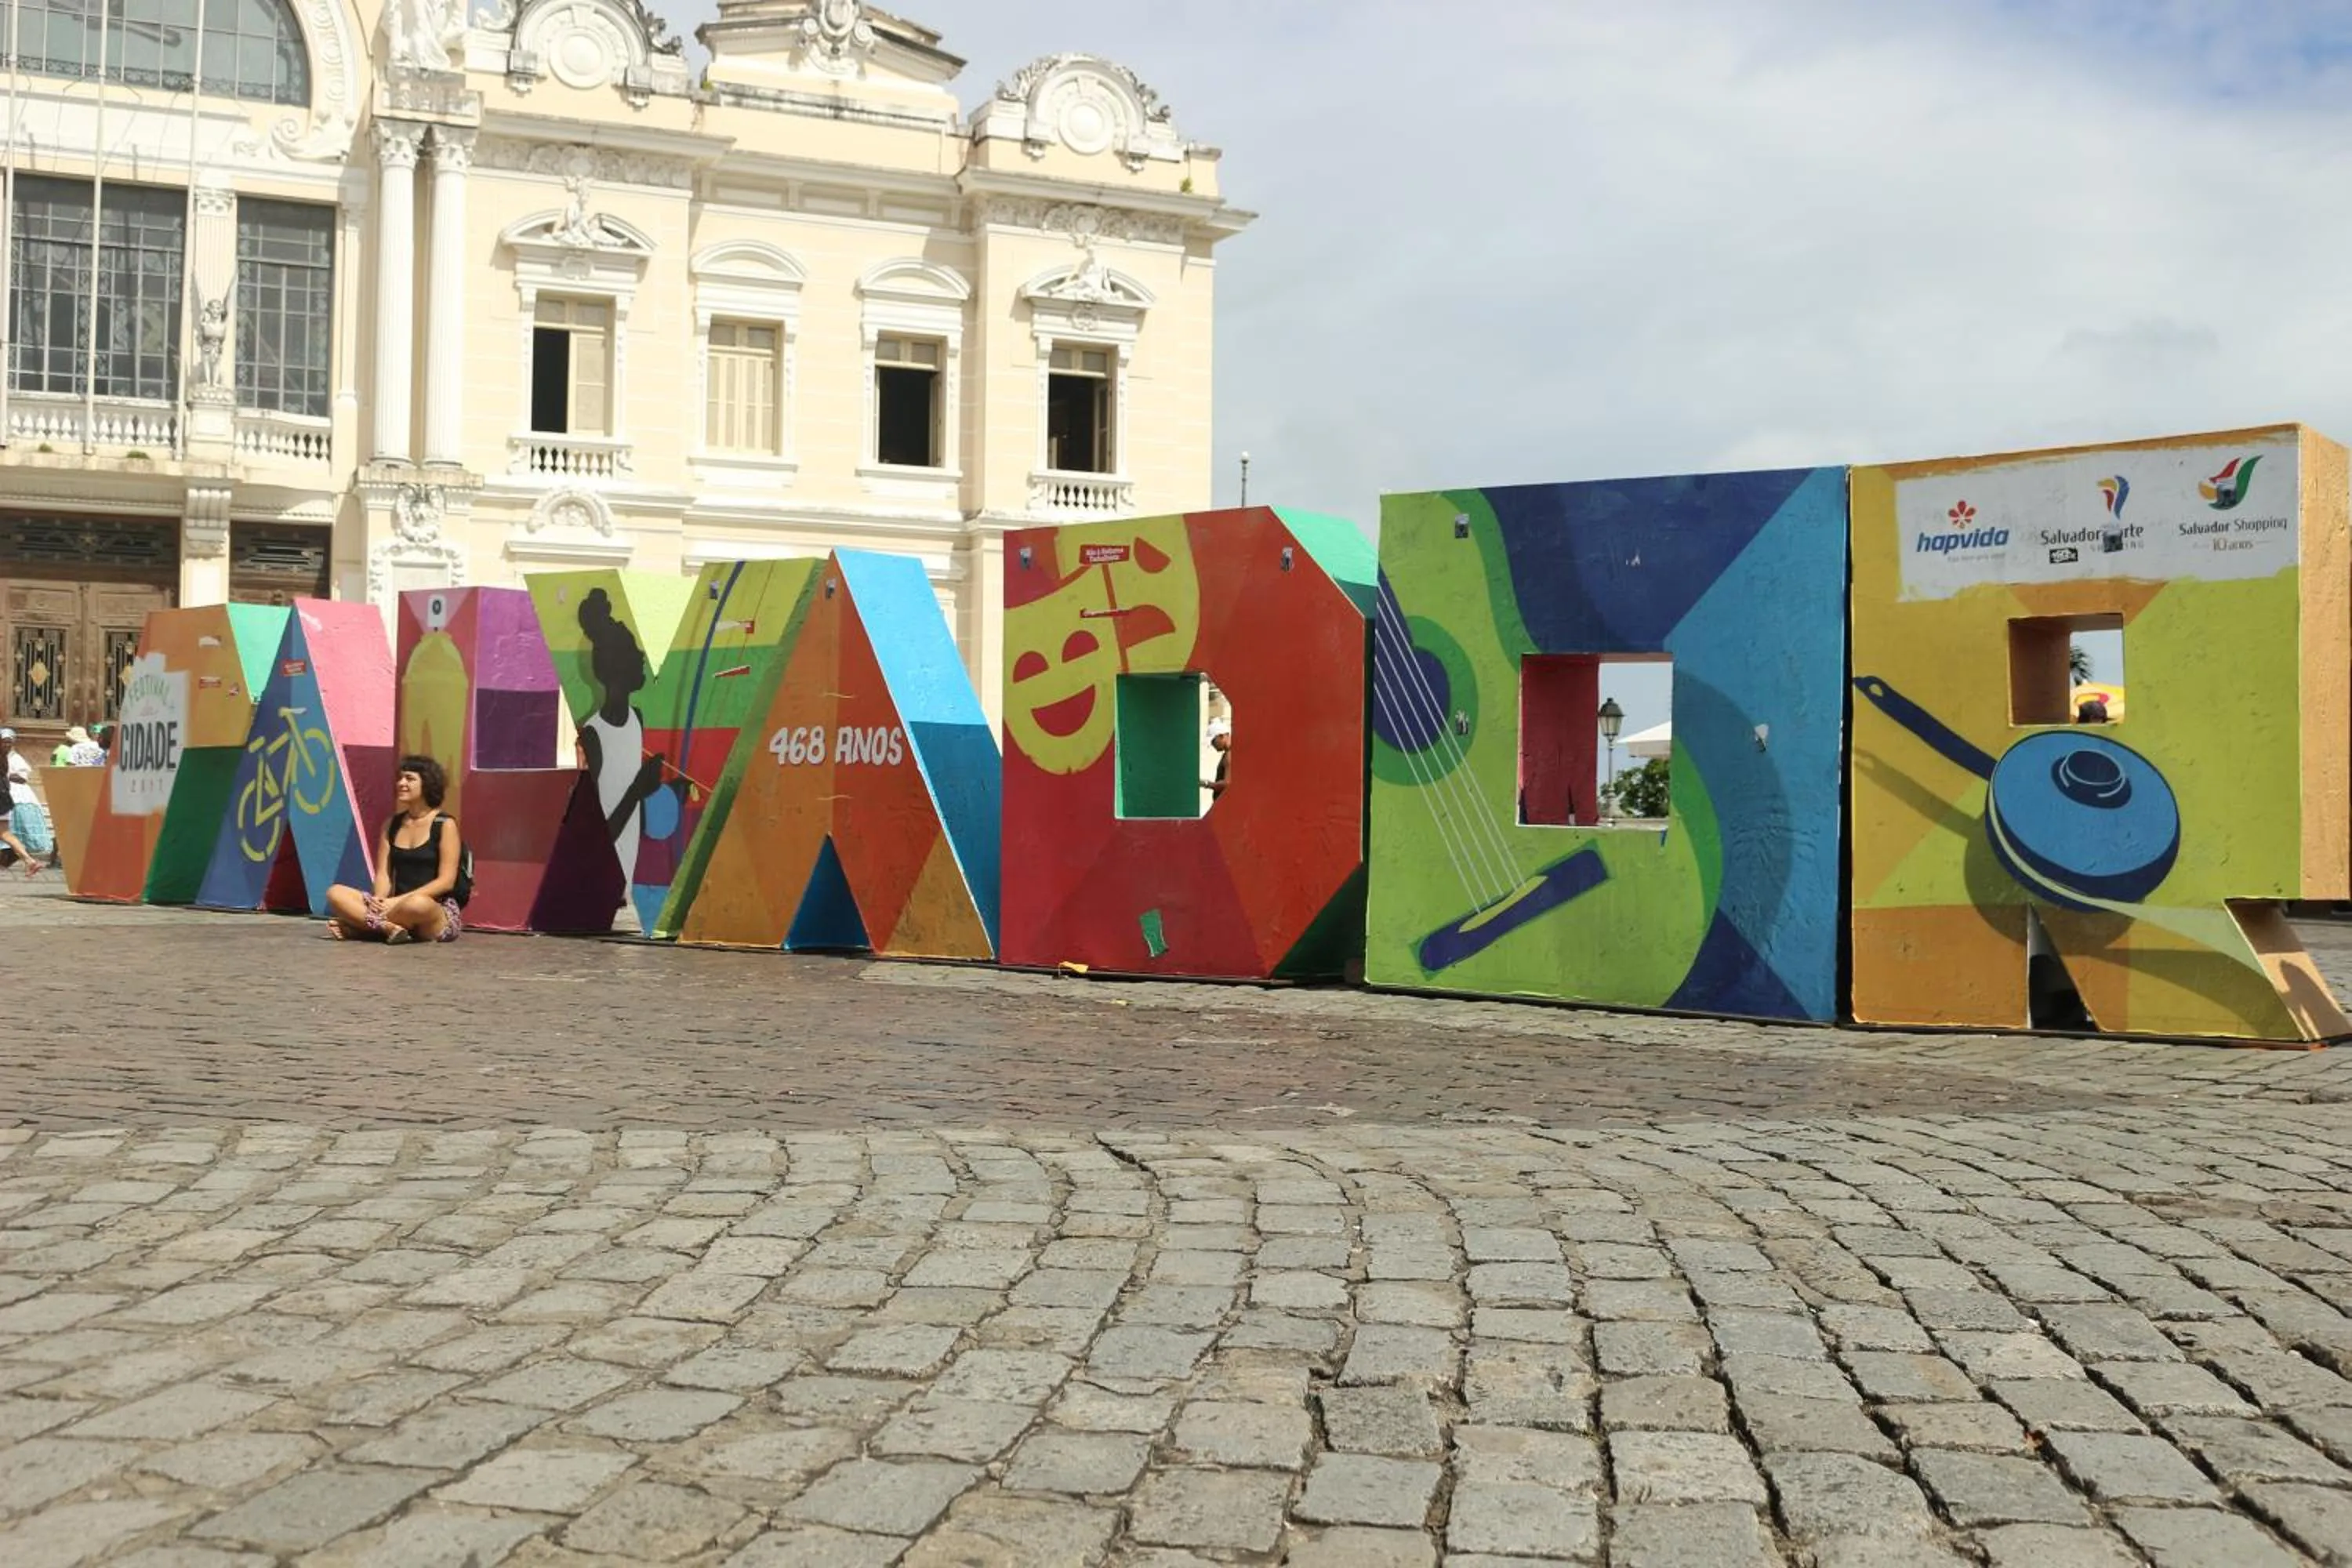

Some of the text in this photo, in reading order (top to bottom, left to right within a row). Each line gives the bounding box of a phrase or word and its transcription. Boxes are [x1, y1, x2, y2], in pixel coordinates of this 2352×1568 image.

[2041, 527, 2102, 545] Salvador
[2179, 516, 2288, 535] Salvador Shopping
[1916, 527, 2009, 555] hapvida
[119, 720, 178, 772] CIDADE
[769, 725, 903, 766] 468 ANOS
